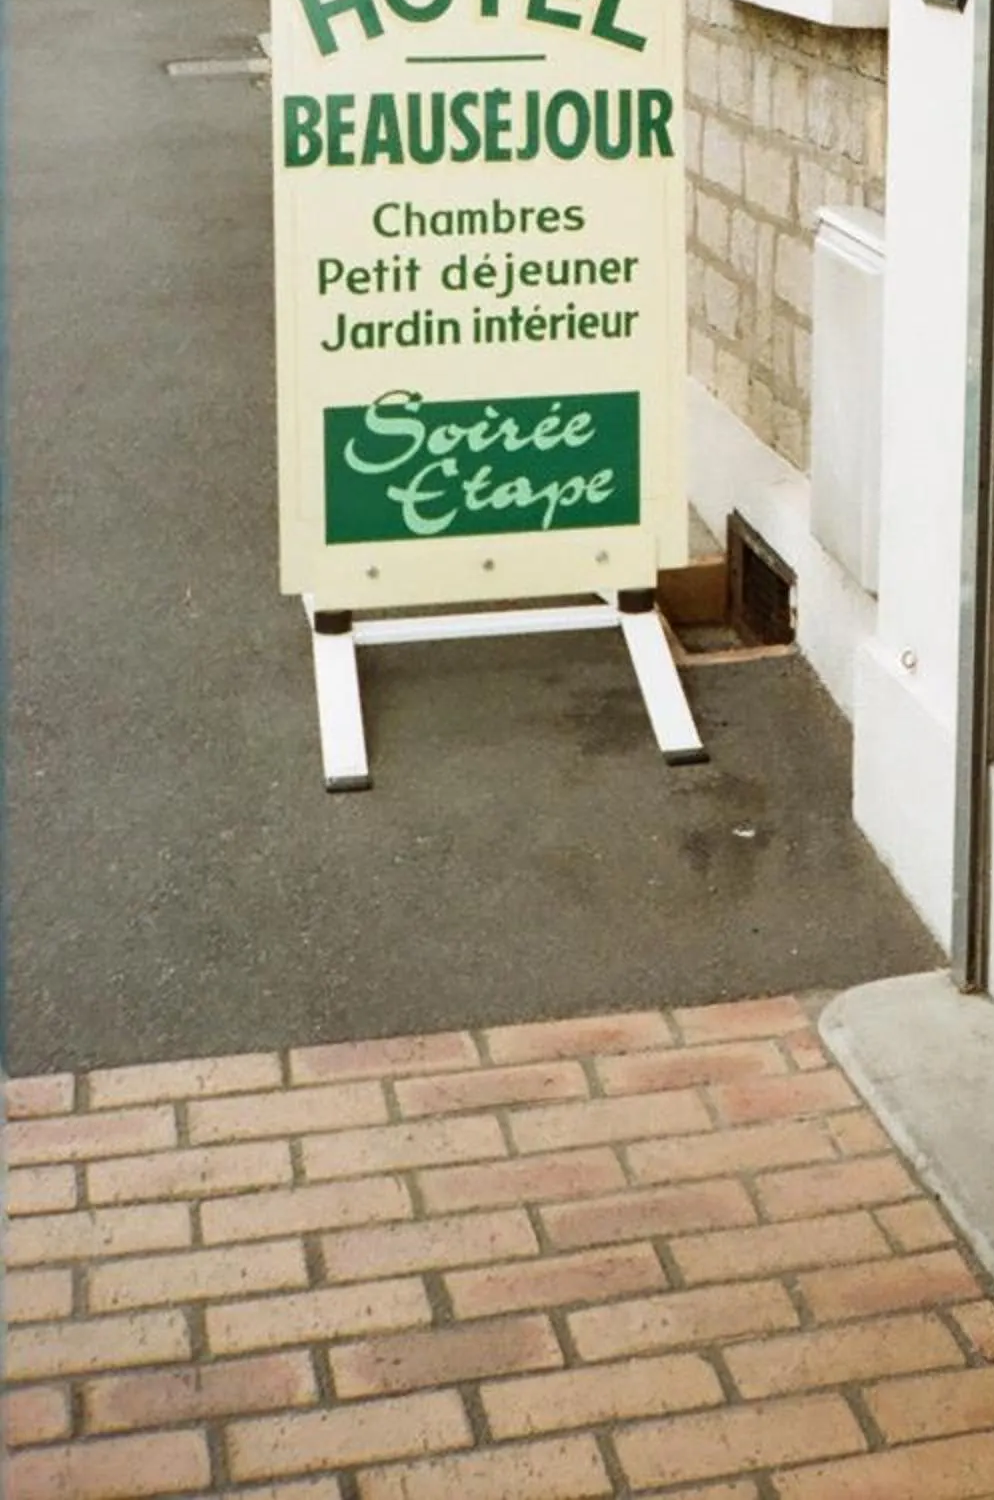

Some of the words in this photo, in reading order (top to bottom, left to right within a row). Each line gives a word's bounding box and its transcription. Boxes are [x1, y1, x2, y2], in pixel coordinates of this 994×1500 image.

[283, 87, 675, 168] BEAUSÉJOUR
[372, 197, 586, 238] Chambres
[318, 254, 422, 296] Petit
[440, 252, 640, 299] déjeuner
[320, 309, 462, 352] Jardin
[472, 303, 640, 344] intérieur
[343, 389, 597, 475] Soirée
